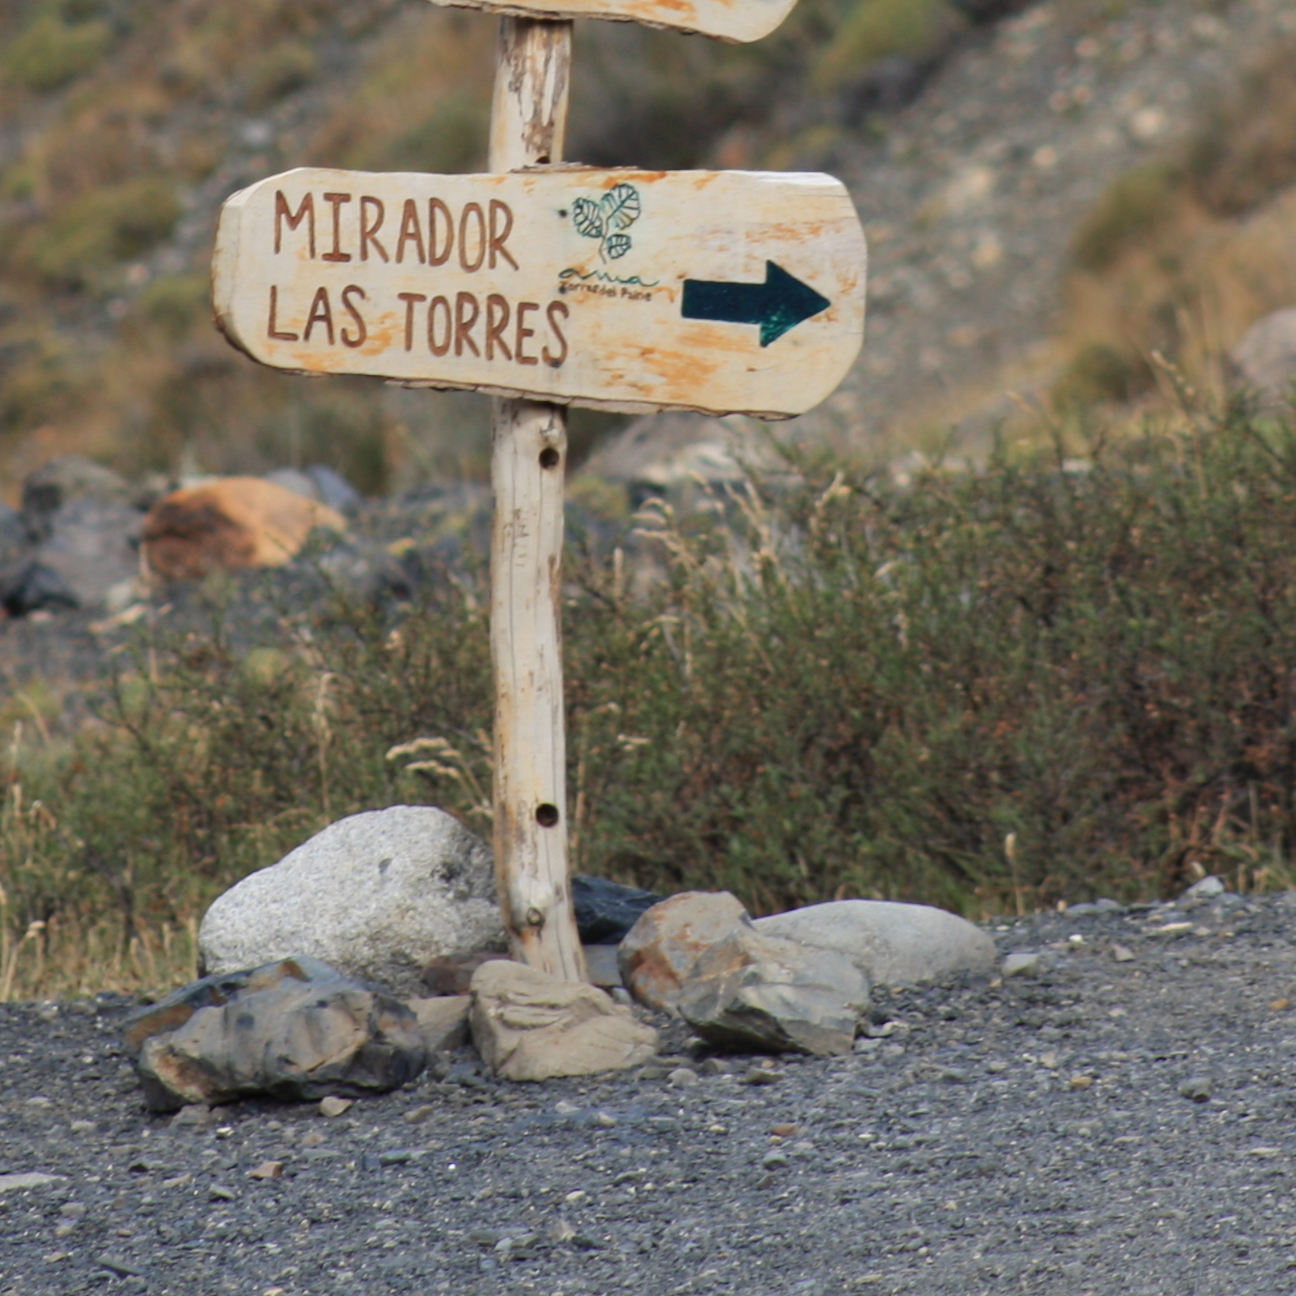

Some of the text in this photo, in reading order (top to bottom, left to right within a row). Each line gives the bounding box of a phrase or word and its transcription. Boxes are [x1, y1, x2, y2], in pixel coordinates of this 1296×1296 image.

[273, 189, 520, 273] MIRADOR
[266, 282, 570, 368] LAS TORRES
